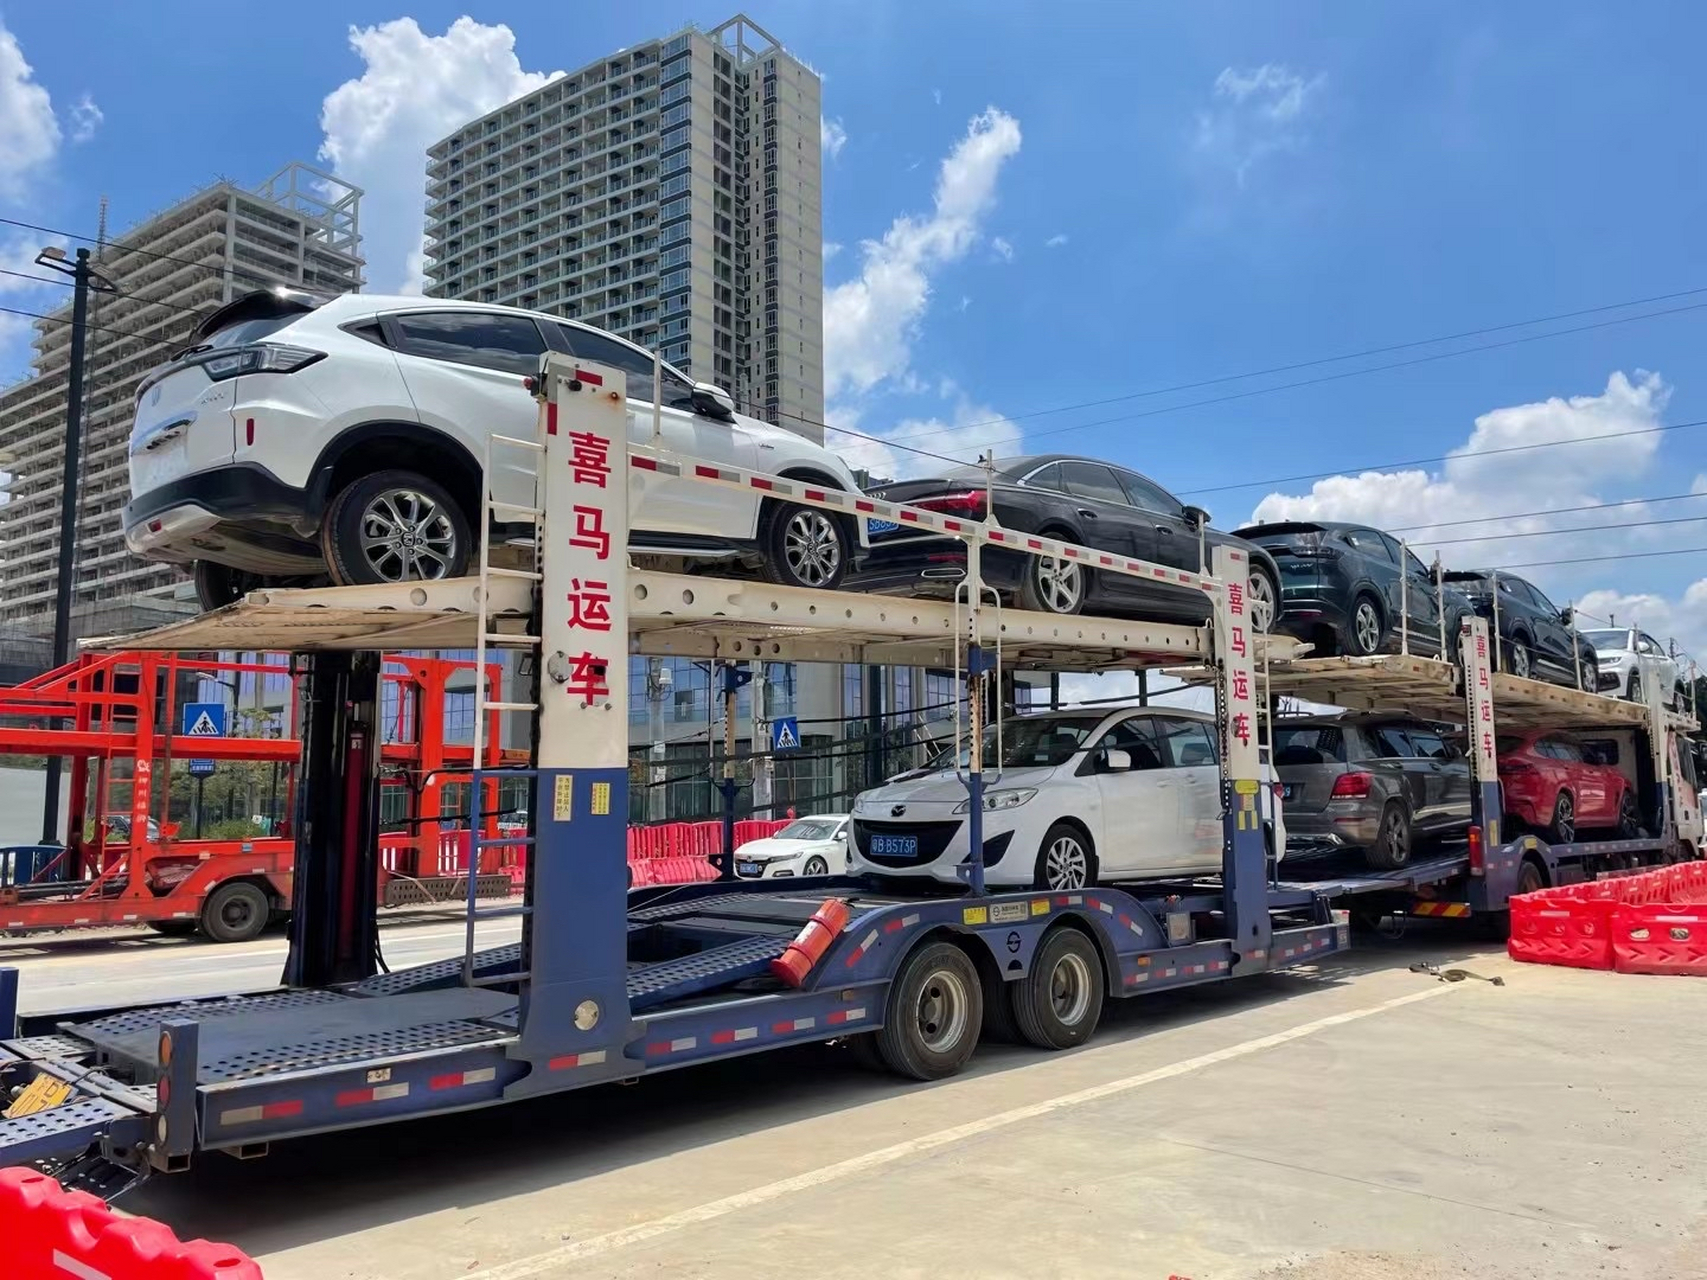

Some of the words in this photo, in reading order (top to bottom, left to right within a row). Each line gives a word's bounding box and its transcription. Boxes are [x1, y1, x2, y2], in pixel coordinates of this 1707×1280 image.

[566, 431, 612, 706] 喜马运车
[1227, 582, 1250, 742] 喜马运车
